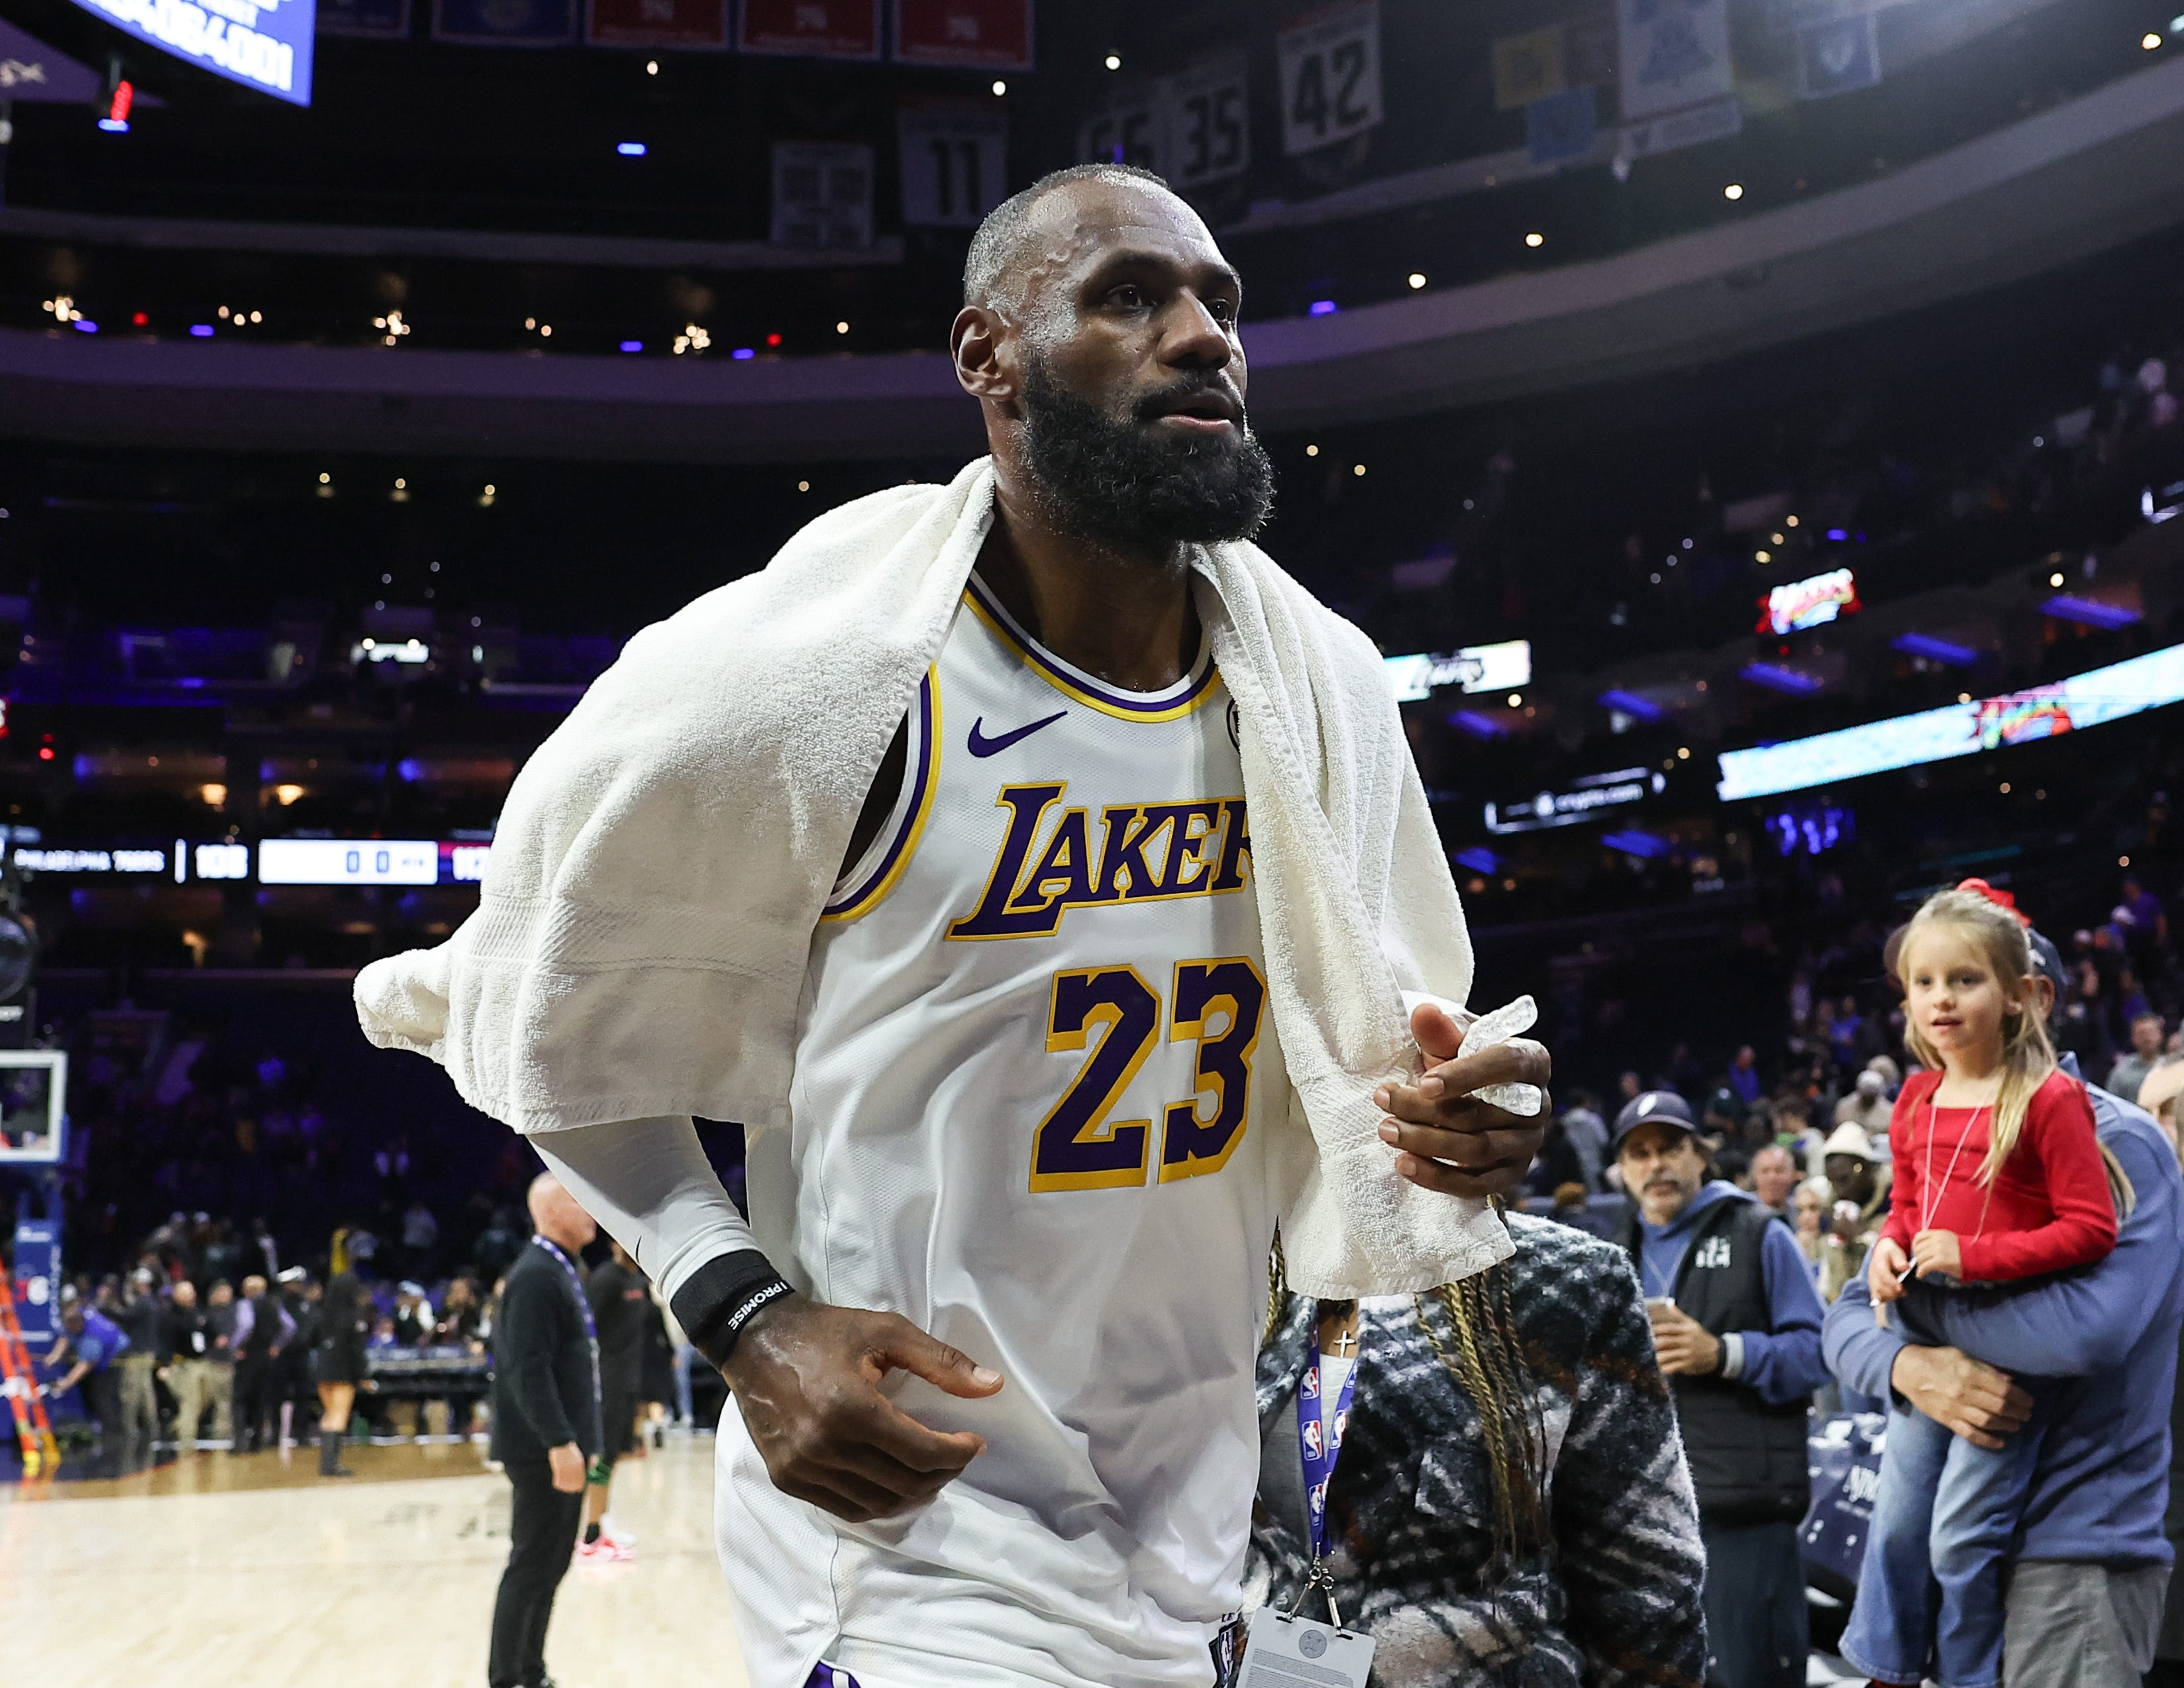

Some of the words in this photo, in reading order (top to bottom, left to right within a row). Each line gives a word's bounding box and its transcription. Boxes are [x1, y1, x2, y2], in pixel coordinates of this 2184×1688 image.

[1295, 40, 1369, 135] 42
[1185, 86, 1241, 176] 35
[931, 139, 982, 217] 11
[1029, 955, 1268, 1194] 23
[727, 1283, 783, 1331] PROMISE
[779, 1281, 788, 1291] I
